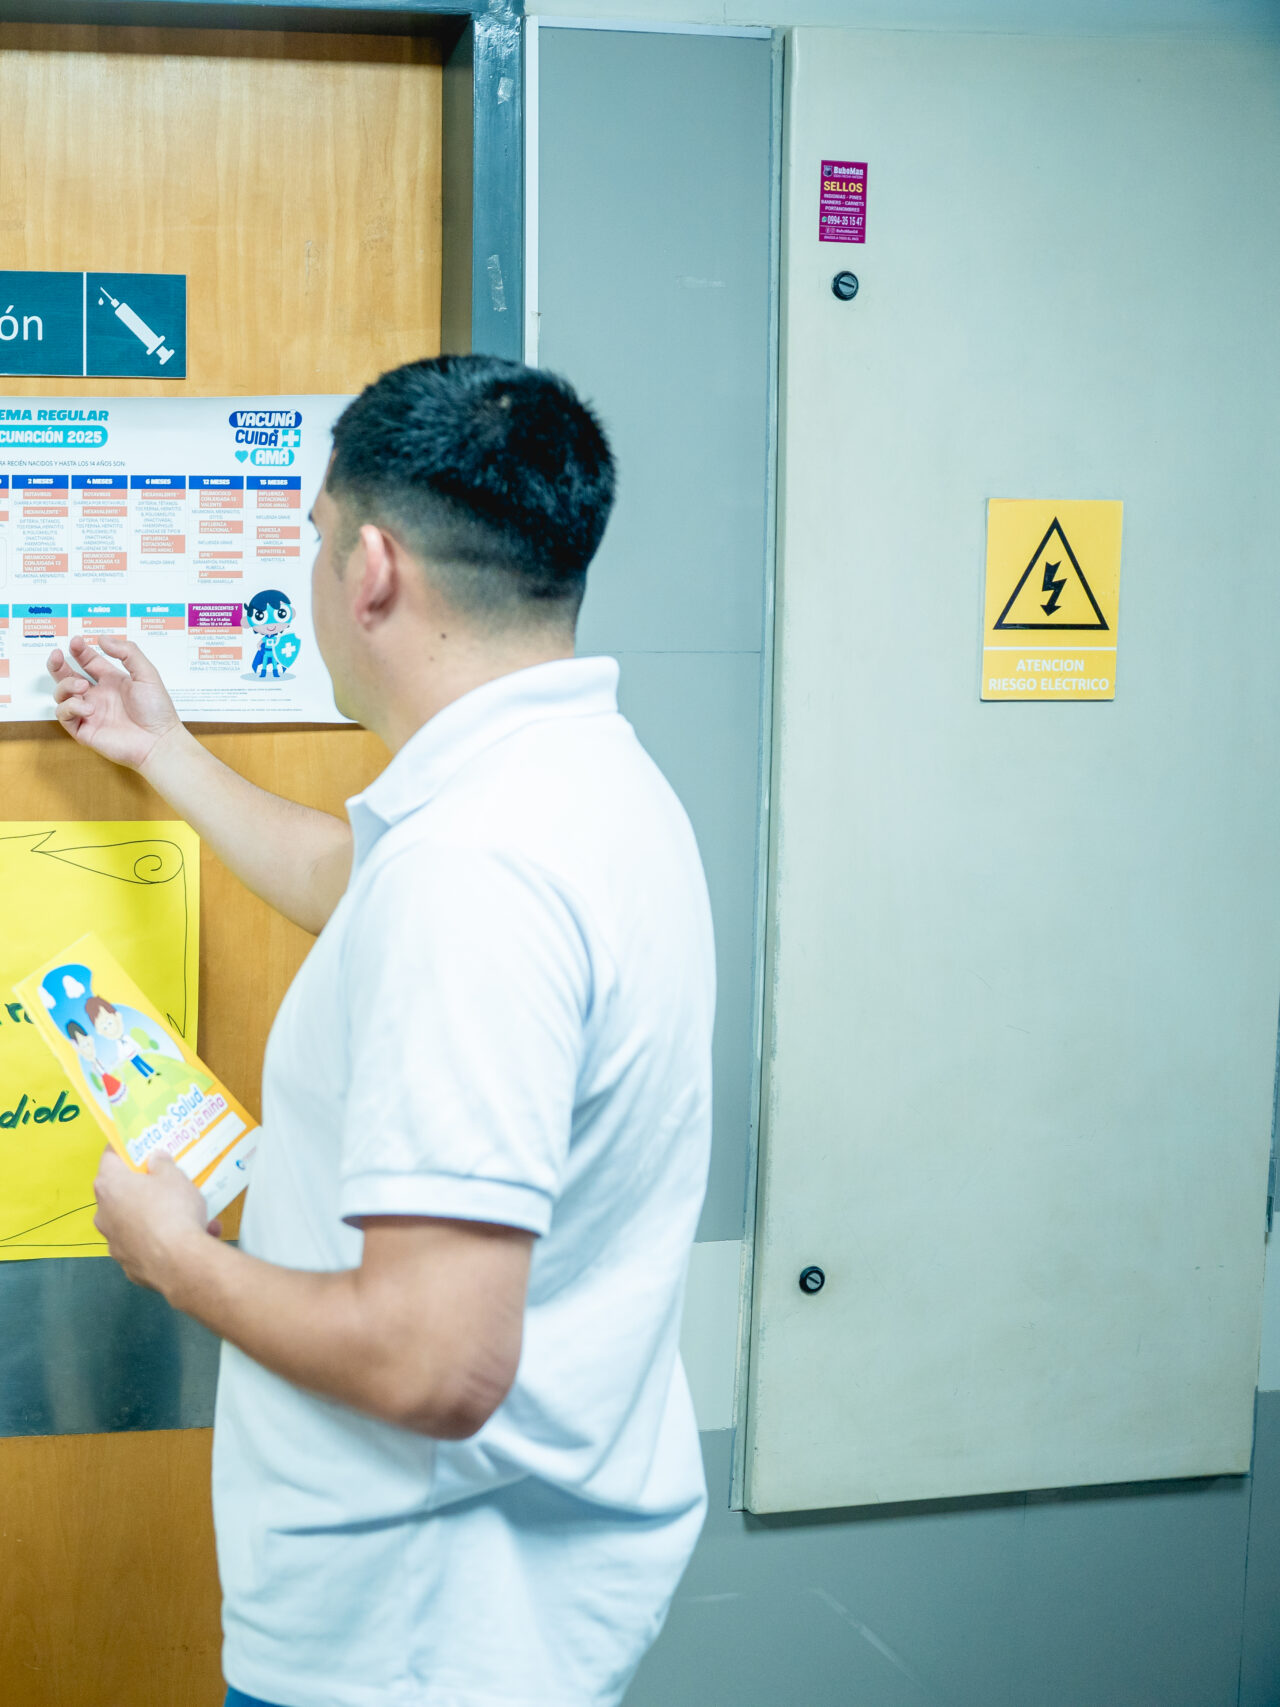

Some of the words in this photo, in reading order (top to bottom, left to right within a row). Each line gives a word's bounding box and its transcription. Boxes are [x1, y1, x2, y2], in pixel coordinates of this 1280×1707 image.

[824, 181, 863, 192] SELLOS
[37, 410, 109, 421] REGULAR
[237, 410, 296, 427] VACUNÁ
[67, 431, 102, 443] 2025
[1016, 659, 1084, 672] ATENCION
[988, 678, 1037, 691] RIESGO
[1041, 678, 1109, 690] ELECTRICO
[170, 1087, 203, 1122] Salud
[202, 1097, 225, 1120] niña
